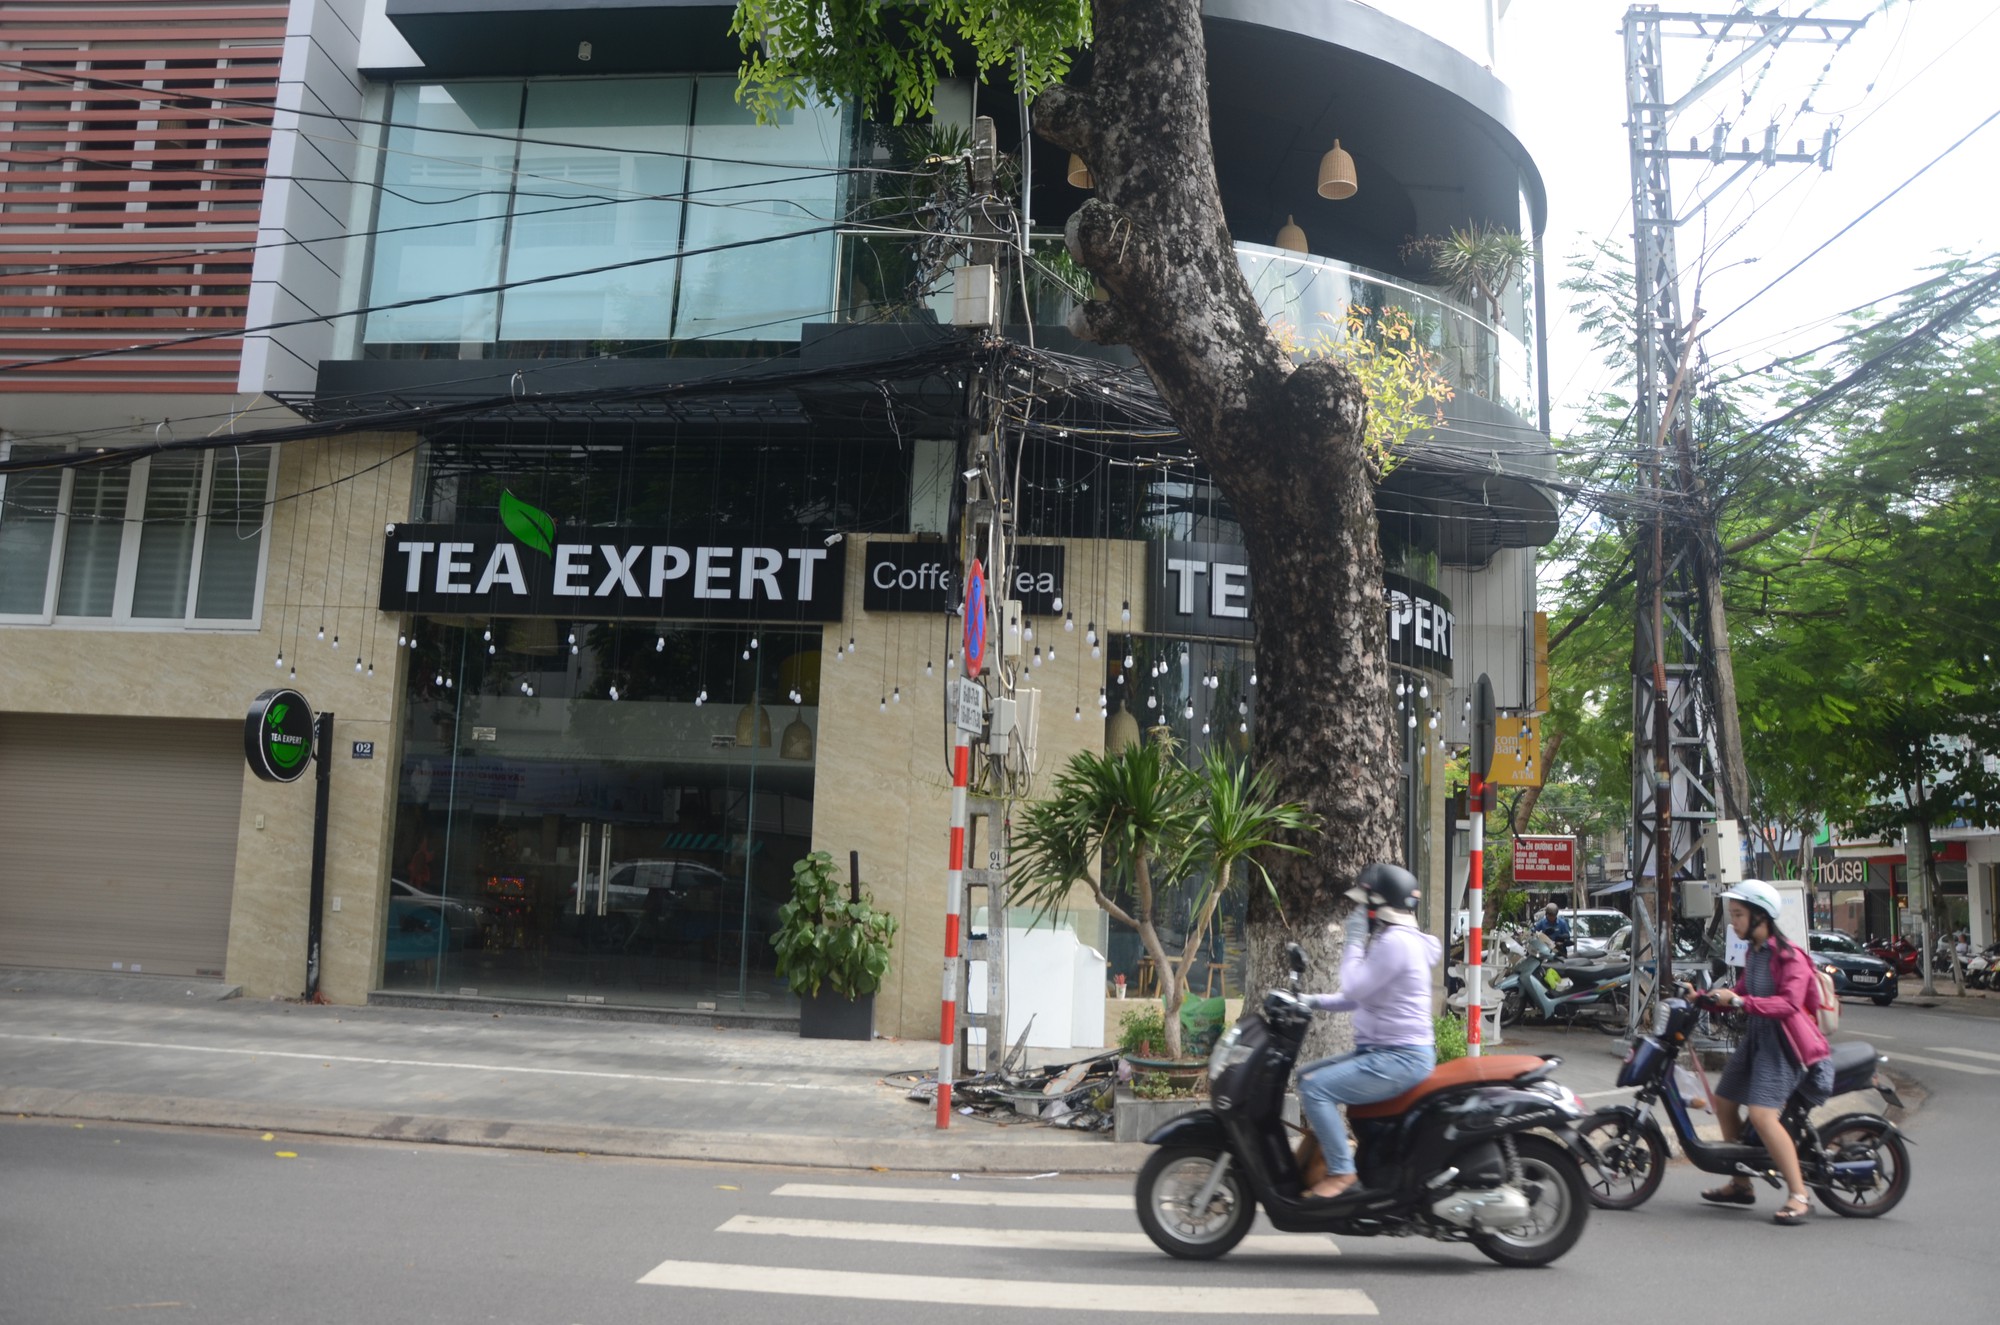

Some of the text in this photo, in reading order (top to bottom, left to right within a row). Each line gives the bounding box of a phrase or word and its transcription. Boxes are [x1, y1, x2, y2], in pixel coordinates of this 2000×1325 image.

[398, 542, 828, 600] TEA EXPERT
[873, 561, 950, 590] Coffe
[1168, 559, 1456, 660] TE PERT
[271, 732, 302, 745] TEA EXPERT
[356, 742, 371, 753] 02
[1512, 770, 1534, 780] ATM
